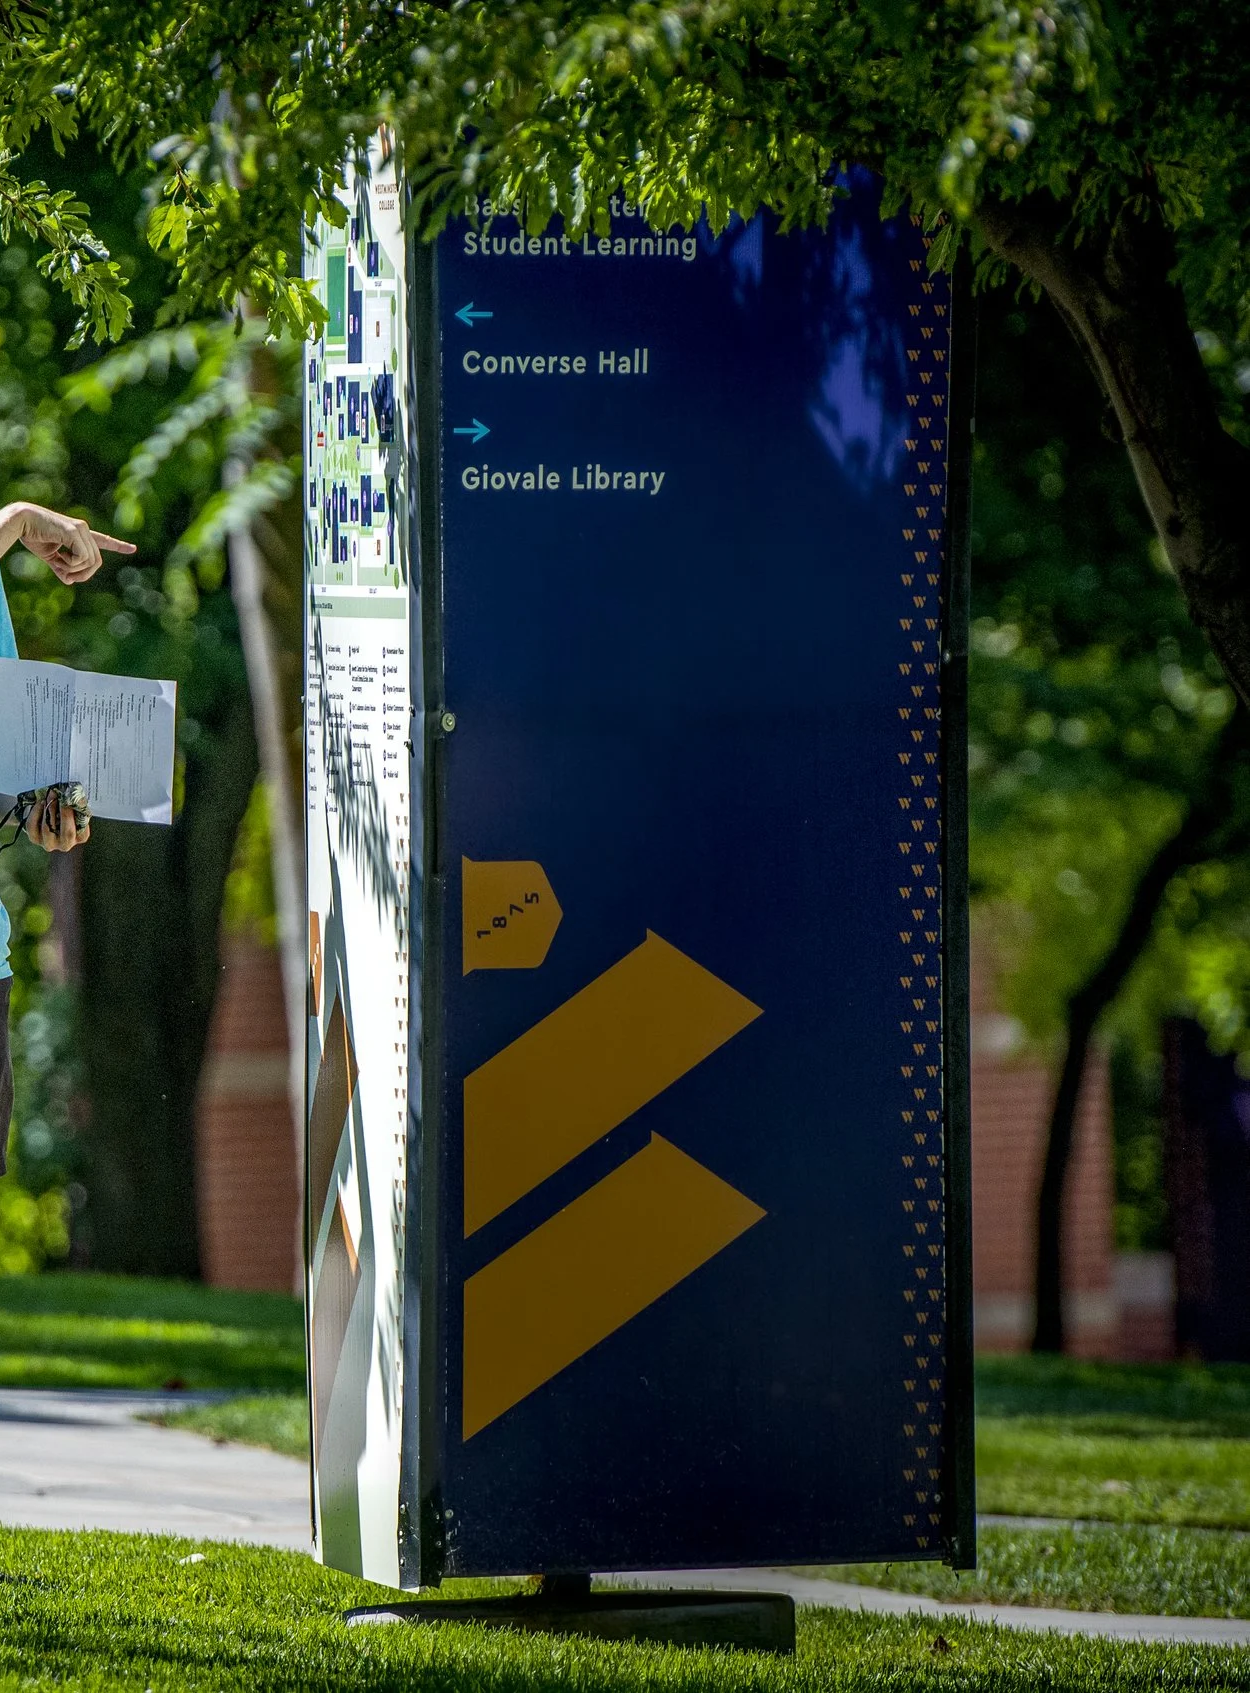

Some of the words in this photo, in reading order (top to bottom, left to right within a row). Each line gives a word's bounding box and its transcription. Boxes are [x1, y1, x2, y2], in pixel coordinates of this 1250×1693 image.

[463, 229, 572, 256] Student
[582, 230, 698, 262] Learning
[462, 350, 587, 375] Converse
[598, 348, 650, 375] Hall
[461, 464, 561, 491] Giovale
[571, 464, 666, 496] Library
[476, 892, 540, 939] 1875
